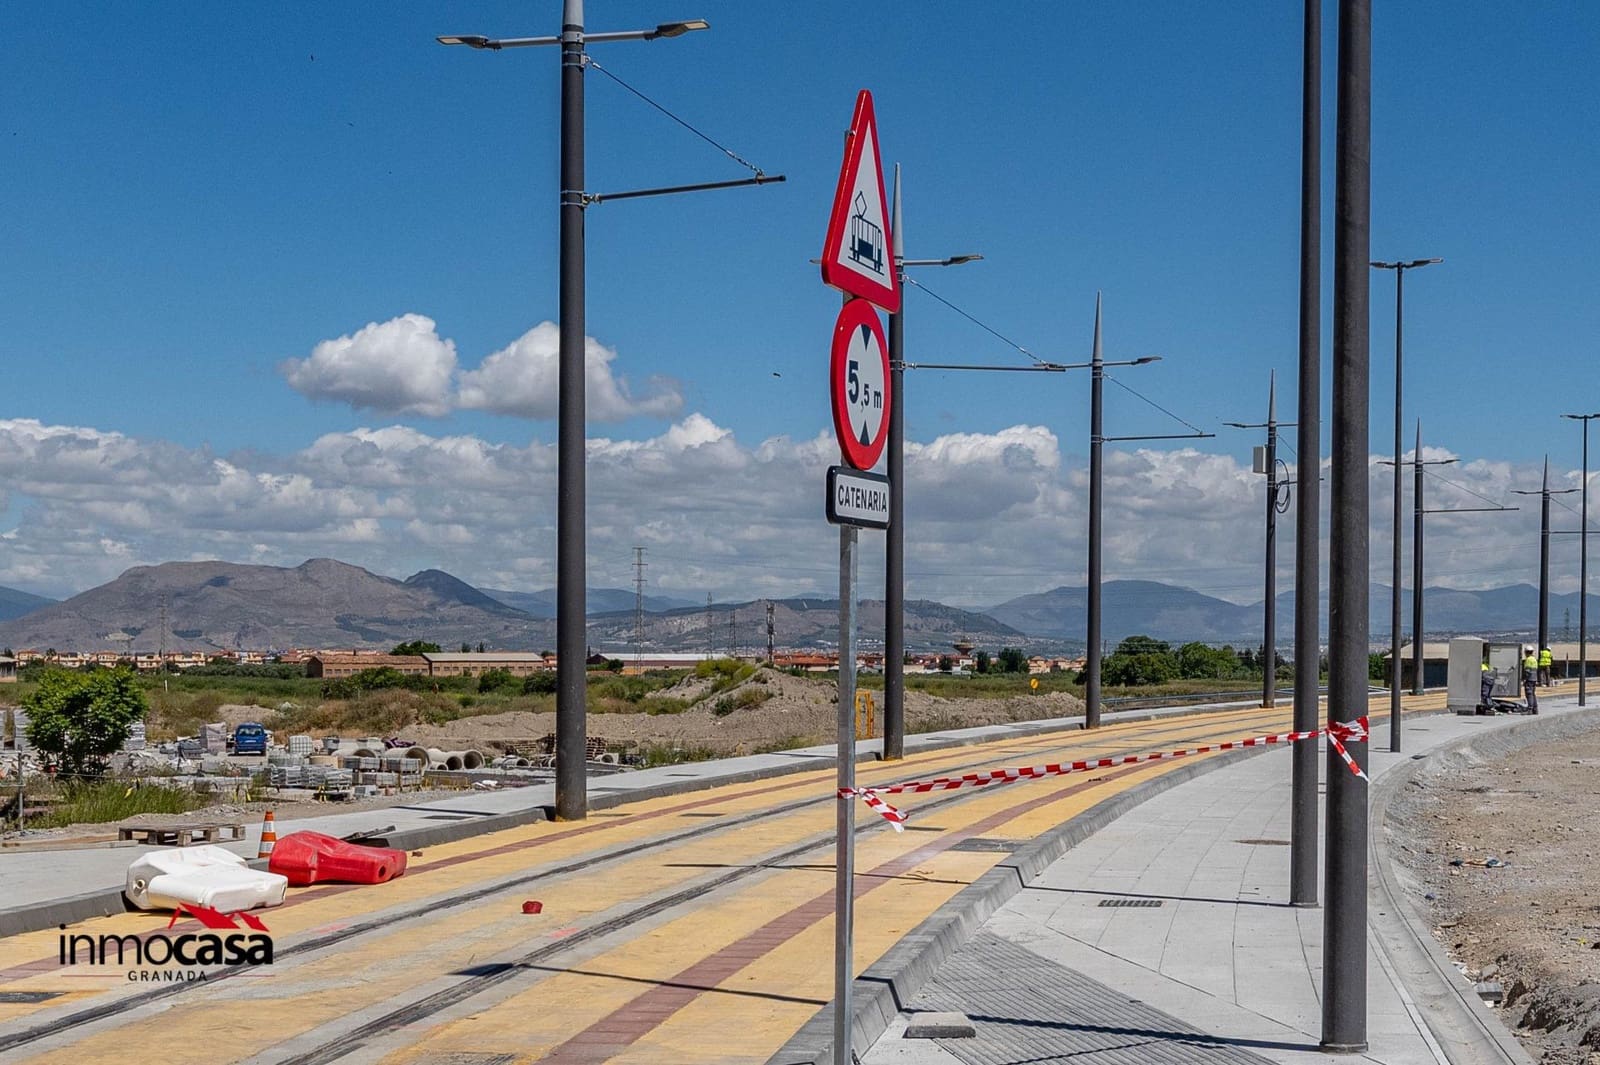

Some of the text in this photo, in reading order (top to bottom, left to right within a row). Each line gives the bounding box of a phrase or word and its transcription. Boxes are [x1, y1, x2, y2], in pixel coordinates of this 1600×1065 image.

[848, 360, 882, 412] 5,5 m
[838, 485, 887, 513] CATENARIA
